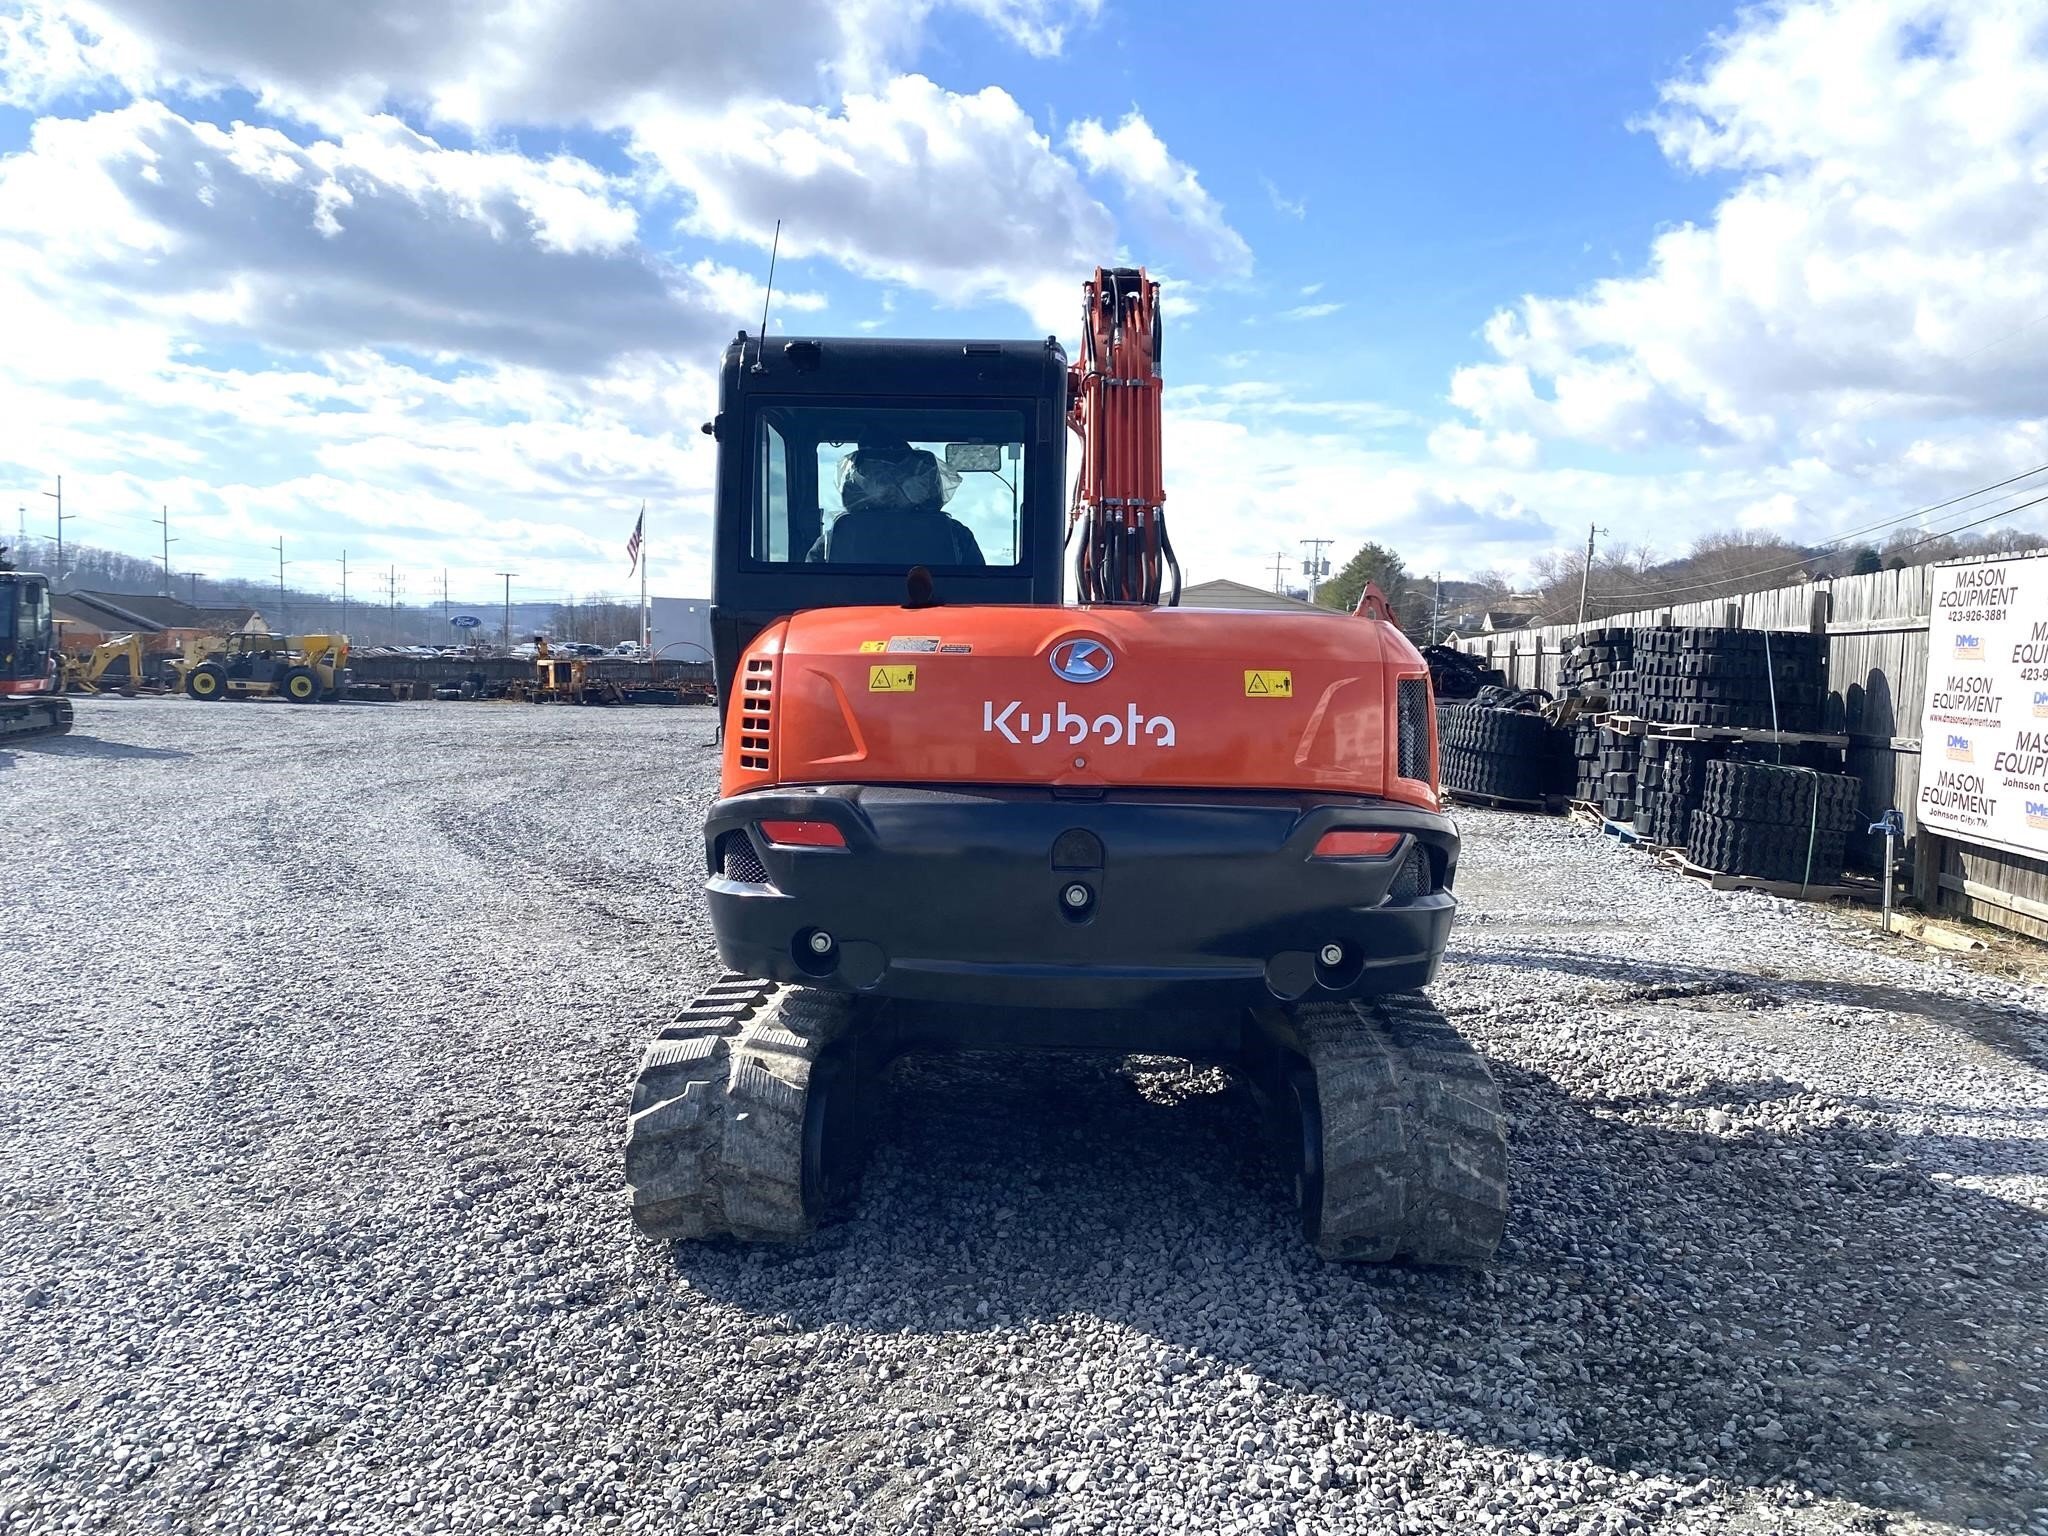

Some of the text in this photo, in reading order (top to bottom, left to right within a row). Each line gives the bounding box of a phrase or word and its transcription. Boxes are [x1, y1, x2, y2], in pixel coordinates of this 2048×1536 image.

[1956, 568, 2006, 588] MASON
[1939, 587, 2018, 607] EQUIPMENT
[1948, 609, 2006, 622] 423-926-3881
[1947, 676, 1993, 694] MASON
[1932, 693, 2002, 713] EQUIPMENT
[984, 701, 1175, 746] Kubota
[1994, 752, 2048, 777] EQUIP
[1937, 769, 1985, 794] MASON
[2003, 777, 2040, 791] Johnson
[1921, 786, 1997, 816] EQUIPMENT
[1929, 808, 1958, 820] Johnson
